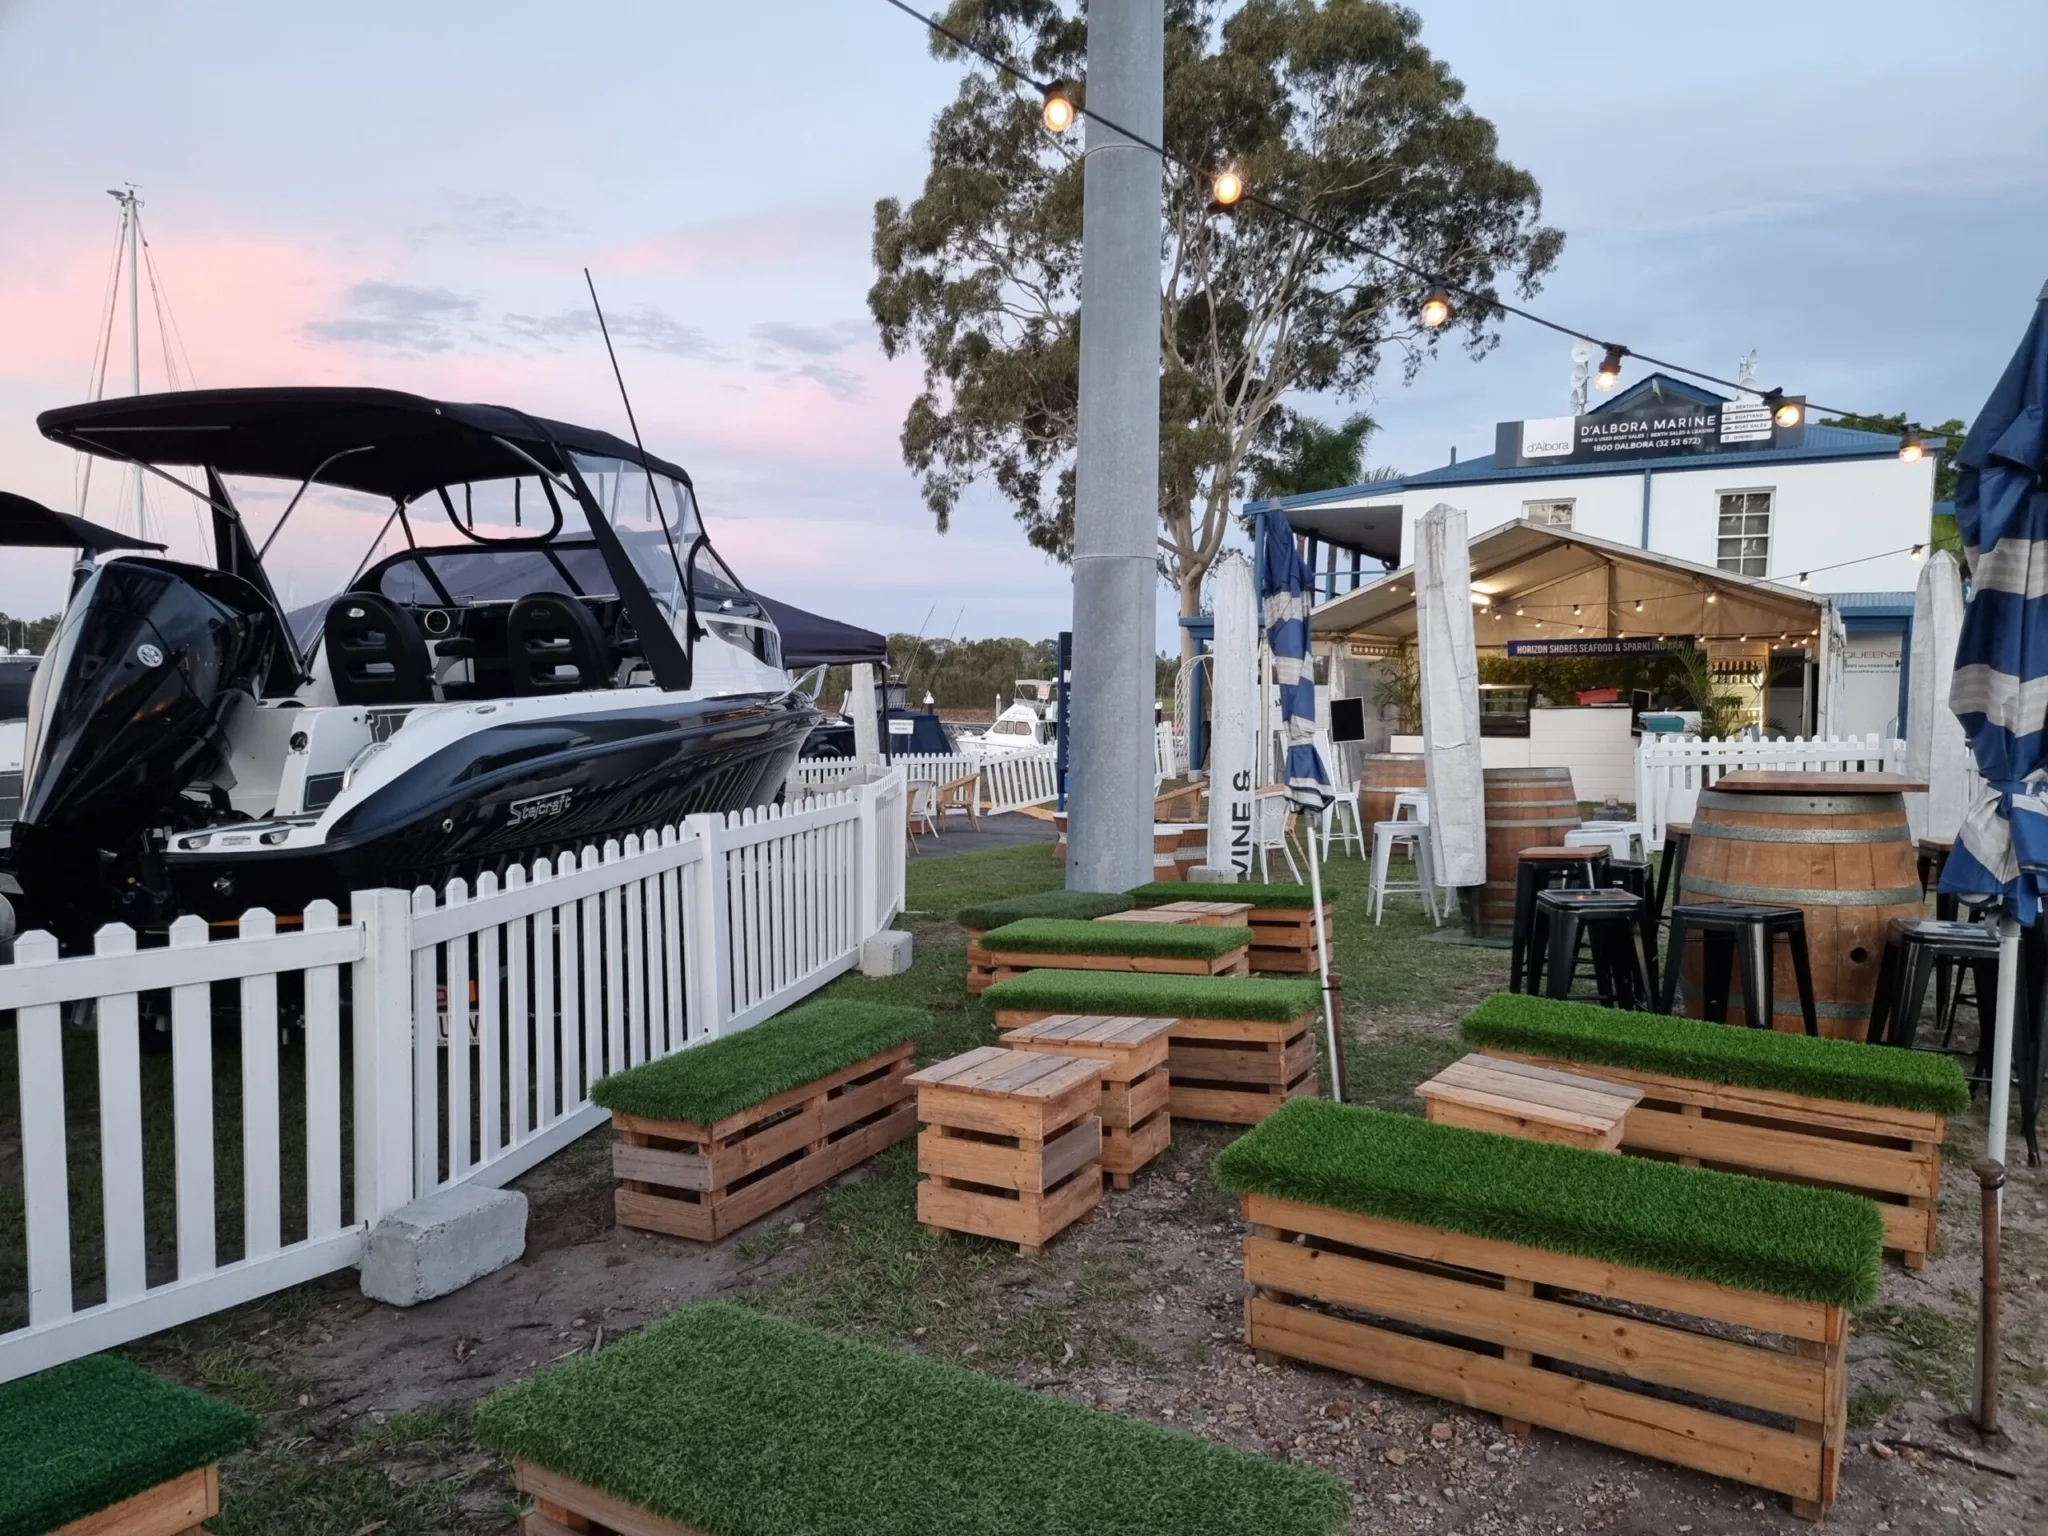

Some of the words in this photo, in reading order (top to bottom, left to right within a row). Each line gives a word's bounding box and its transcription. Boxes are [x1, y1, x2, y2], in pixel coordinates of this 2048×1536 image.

[1581, 421, 1648, 436] D'ALBORA
[1653, 415, 1716, 430] MARINE
[1526, 441, 1569, 453] d'Albora
[1593, 444, 1613, 452] 1800
[1614, 440, 1654, 450] DALBORA
[1655, 439, 1669, 448] (32
[1670, 438, 1681, 447] 52
[1682, 437, 1701, 445] 672)
[1516, 645, 1548, 654] HORIZON
[1549, 644, 1578, 654] SHORES
[1579, 642, 1613, 653] SEAFOOD
[1615, 643, 1622, 652] &
[1623, 641, 1665, 652] SPARKLING
[1232, 769, 1251, 792] &
